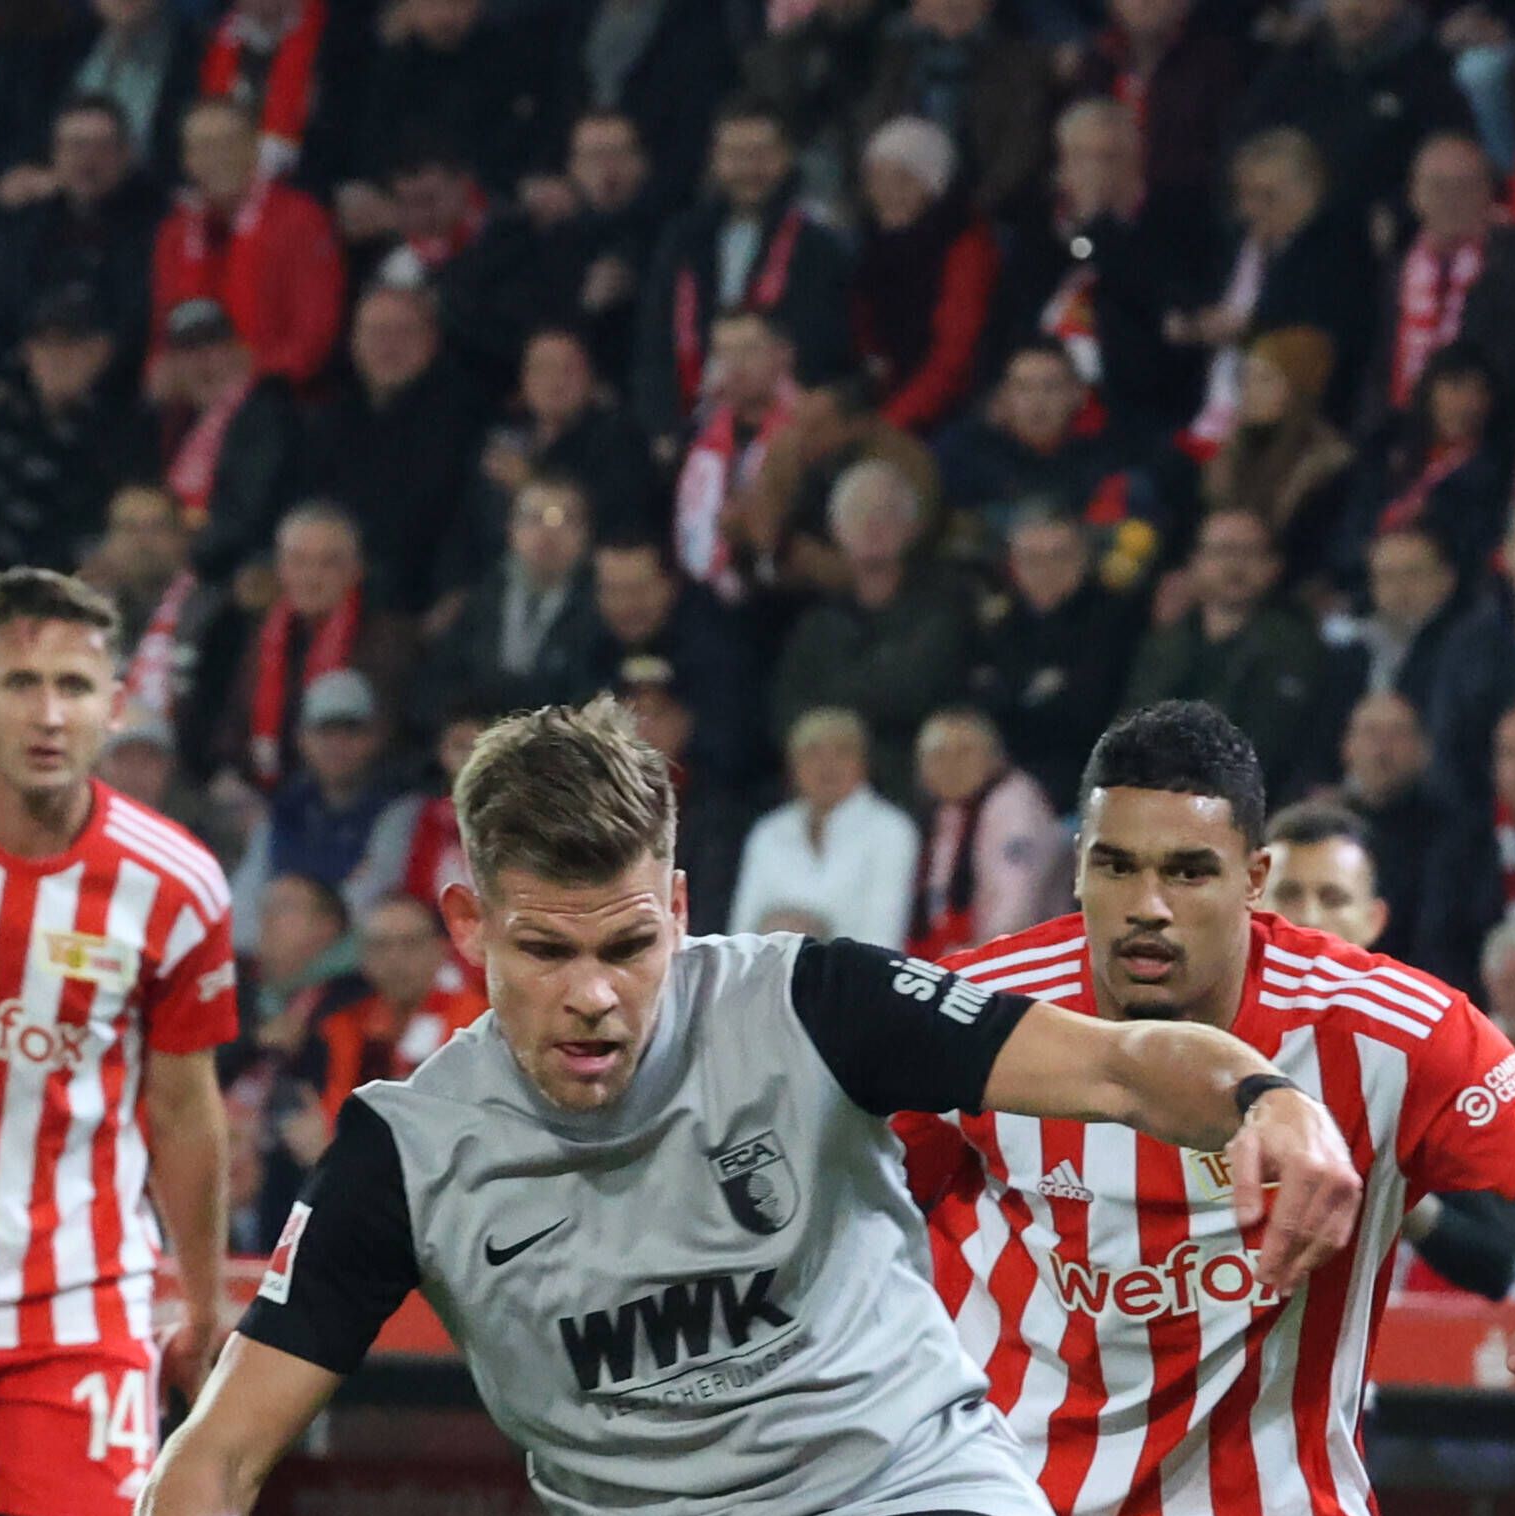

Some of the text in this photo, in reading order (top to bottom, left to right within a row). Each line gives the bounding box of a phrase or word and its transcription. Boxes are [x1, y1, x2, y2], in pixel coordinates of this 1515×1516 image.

[718, 1142, 777, 1176] FCA
[558, 1267, 796, 1392] WWK
[71, 1368, 152, 1465] 14
